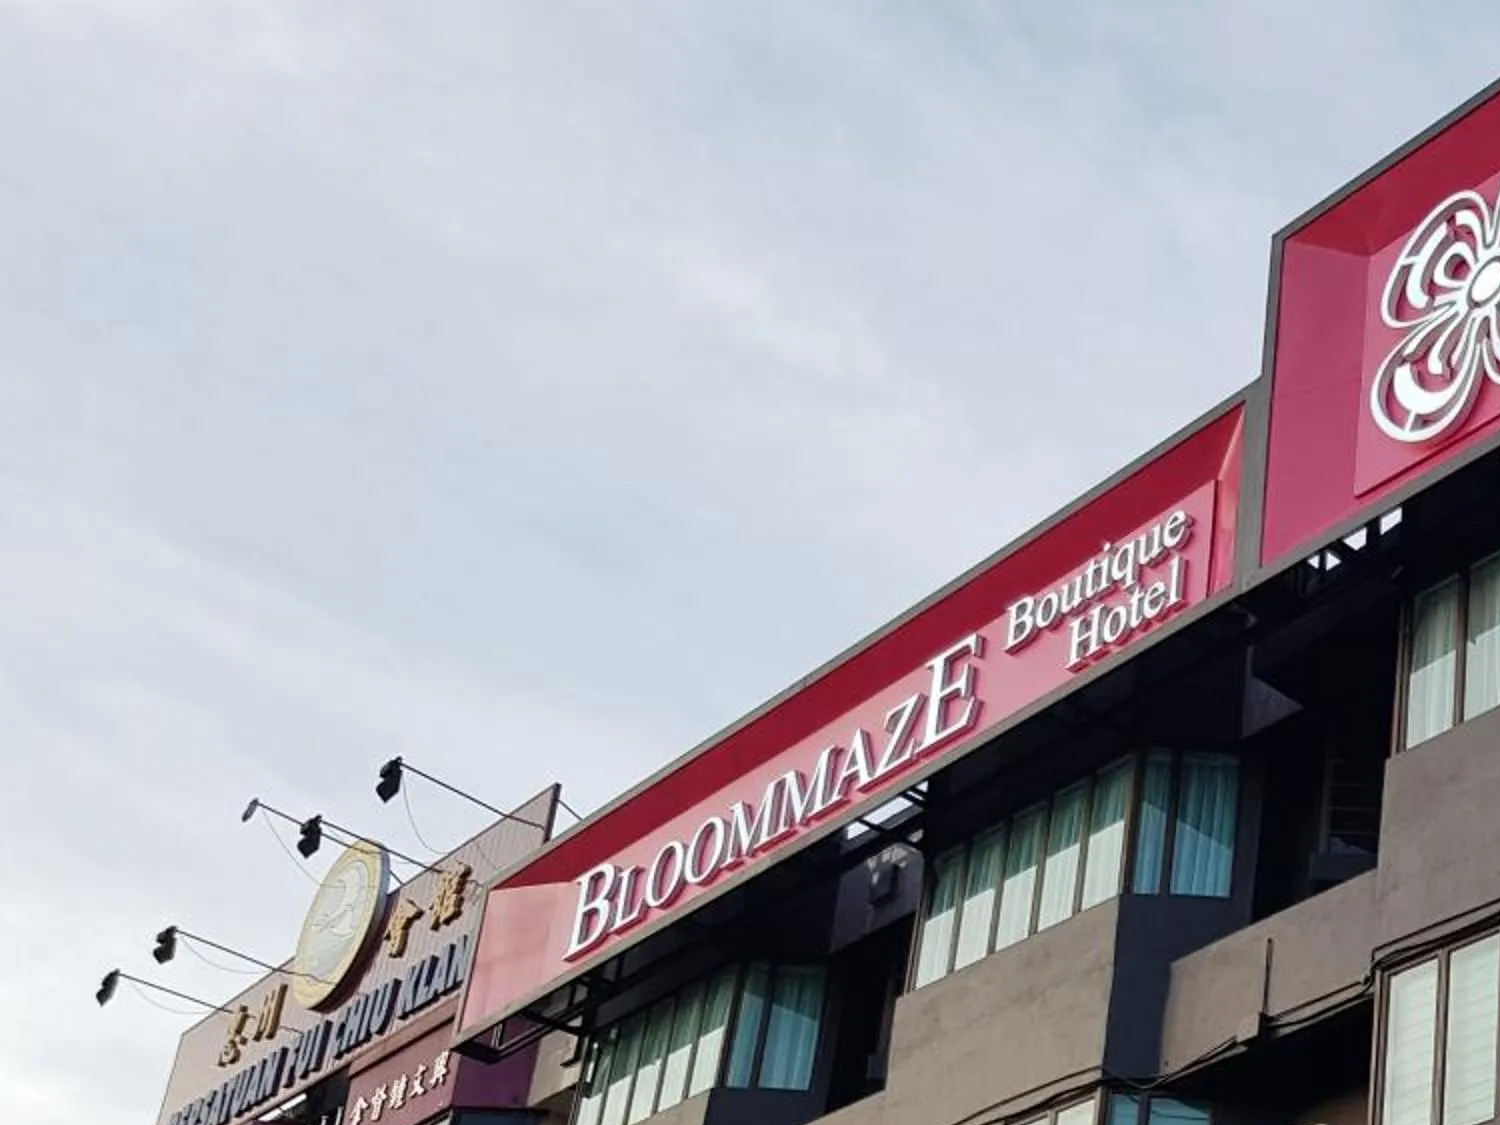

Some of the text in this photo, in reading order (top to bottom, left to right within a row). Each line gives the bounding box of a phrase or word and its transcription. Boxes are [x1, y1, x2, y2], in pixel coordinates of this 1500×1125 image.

[1005, 510, 1190, 652] Boutique
[1066, 554, 1187, 671] Hotel
[563, 634, 986, 962] BLOOMMAZE
